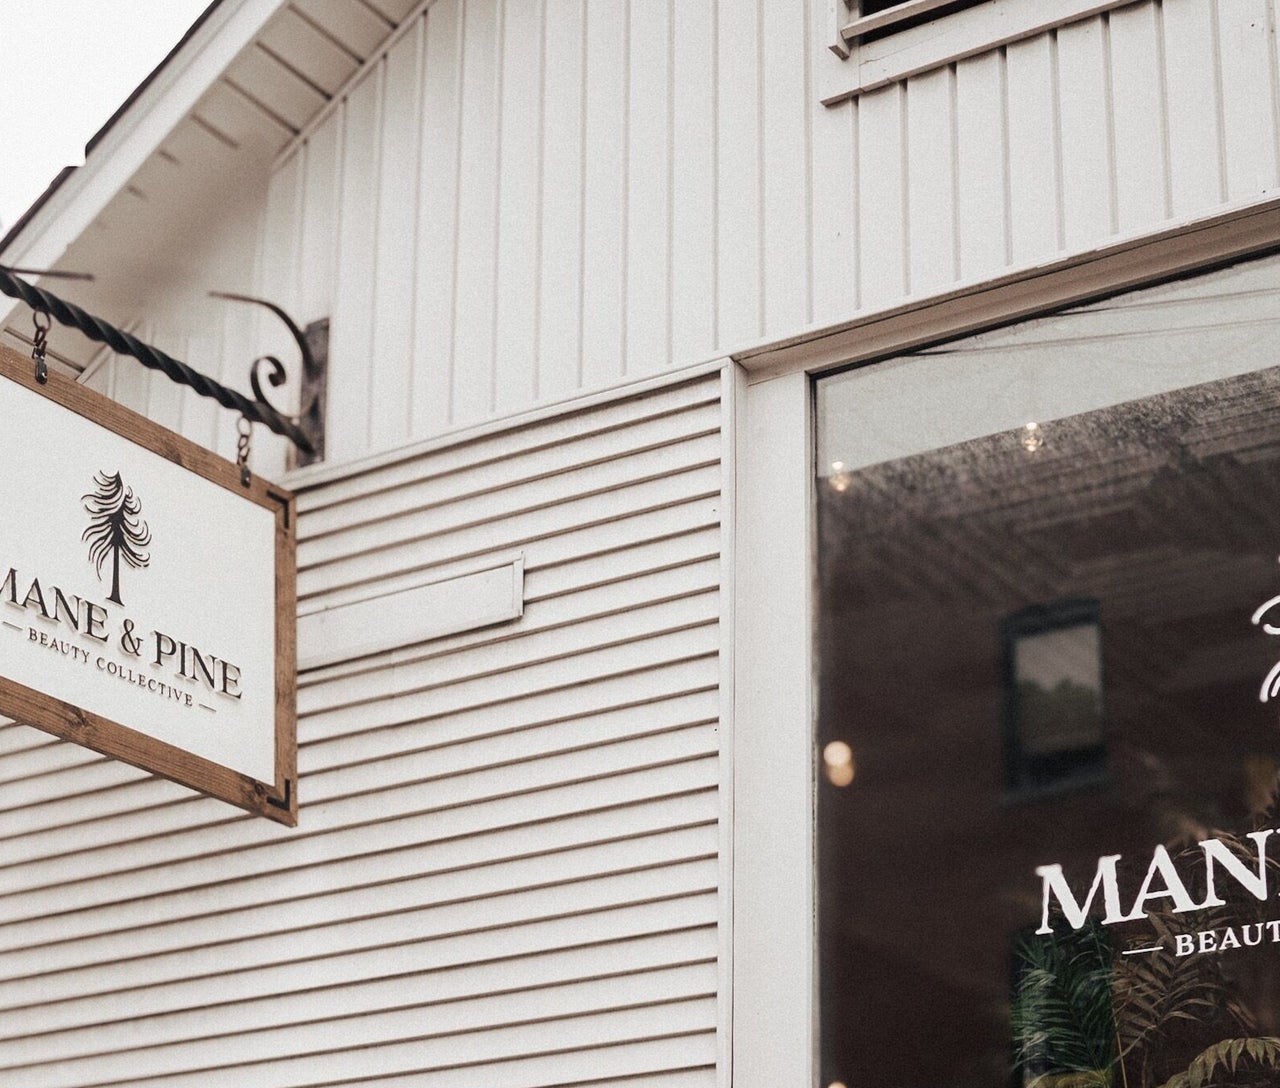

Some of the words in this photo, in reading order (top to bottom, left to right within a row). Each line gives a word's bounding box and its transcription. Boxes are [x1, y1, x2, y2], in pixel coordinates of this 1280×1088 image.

[28, 626, 90, 663] BEAUTY
[96, 656, 193, 707] COLLECTIVE
[120, 618, 144, 657] &
[152, 629, 242, 699] PINE
